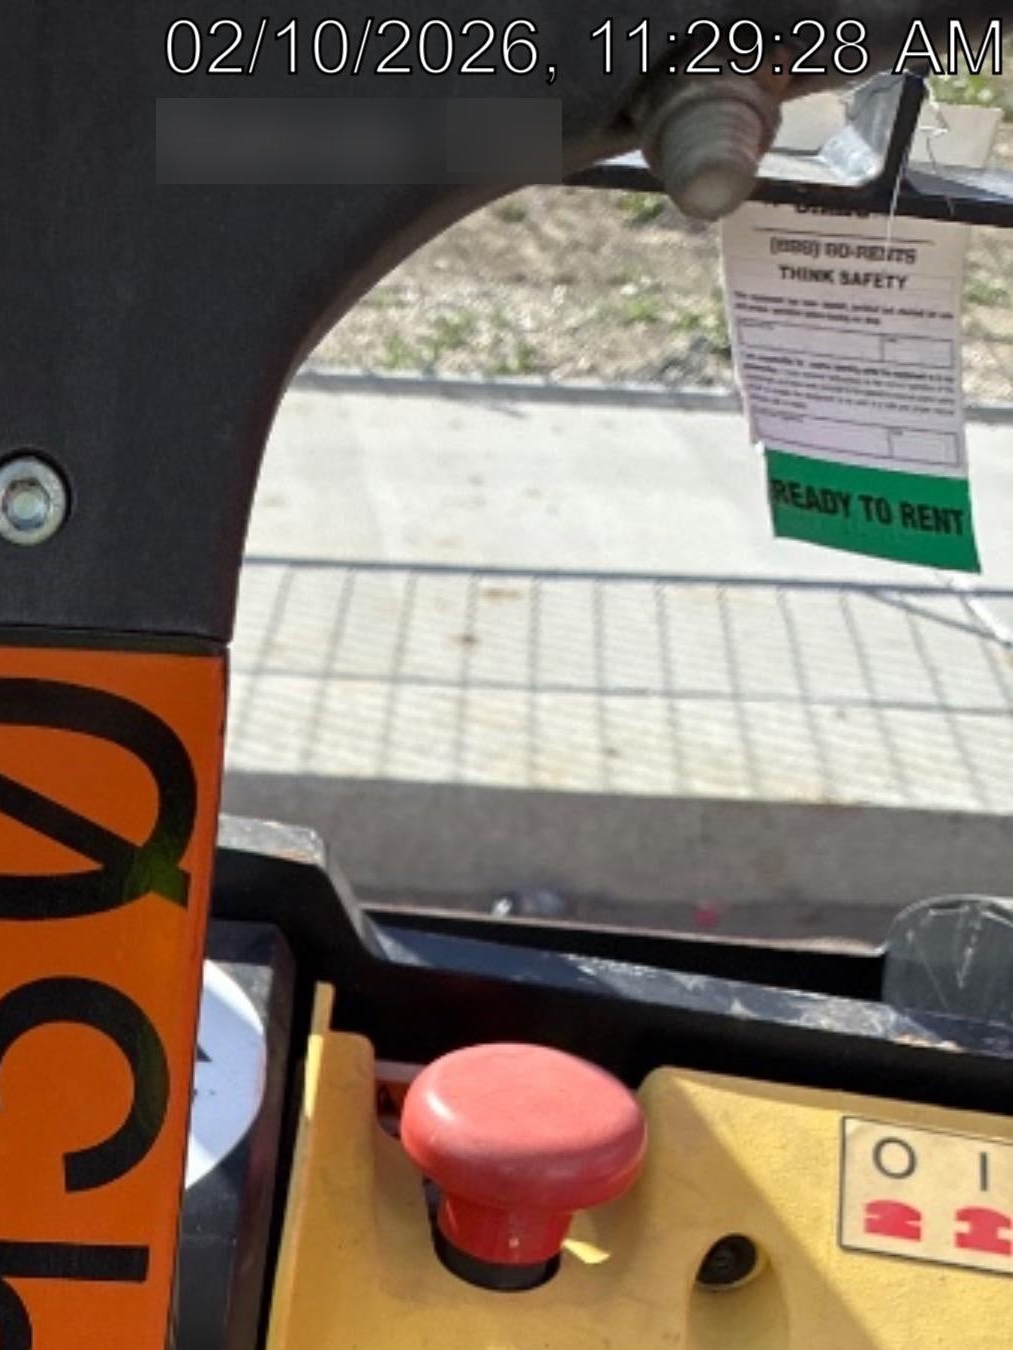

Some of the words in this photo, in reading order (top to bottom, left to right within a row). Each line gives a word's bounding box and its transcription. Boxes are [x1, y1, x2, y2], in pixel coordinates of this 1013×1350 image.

[779, 264, 834, 285] THINK
[839, 270, 909, 290] SAFETY
[769, 479, 852, 518] READY
[857, 493, 893, 526] TO
[899, 500, 964, 536] RENT
